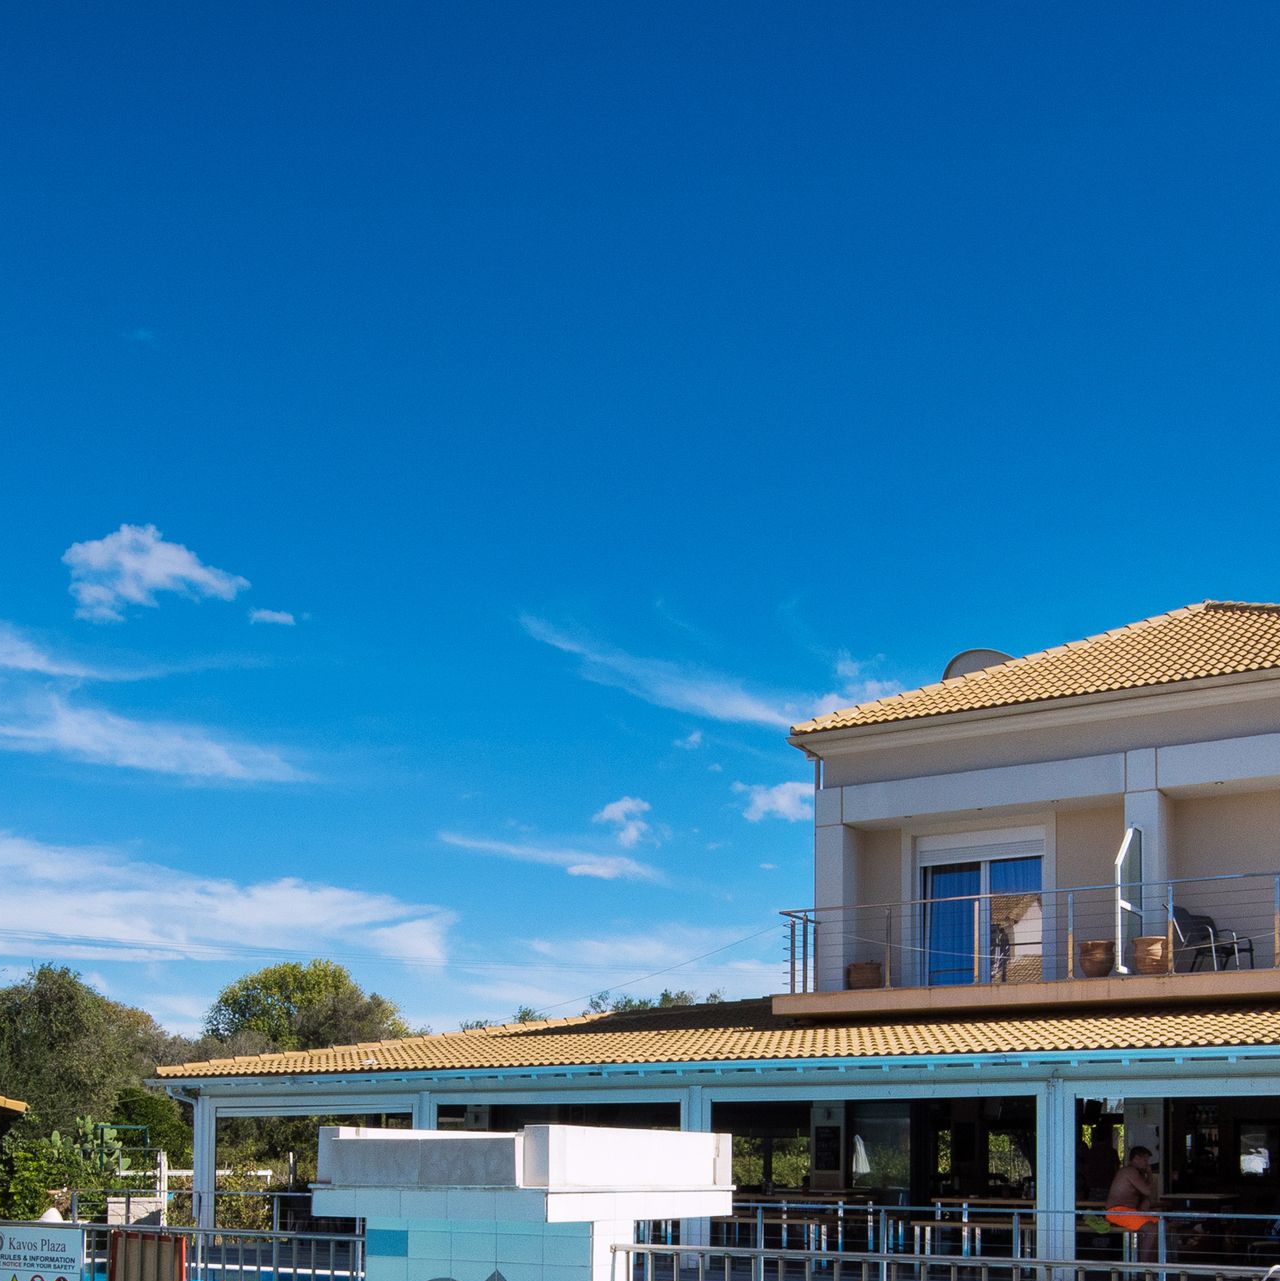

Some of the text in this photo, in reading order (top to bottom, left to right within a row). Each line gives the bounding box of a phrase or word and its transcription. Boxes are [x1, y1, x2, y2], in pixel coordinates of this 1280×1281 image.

[8, 1237, 66, 1252] Kavos Plaza
[0, 1253, 22, 1261] RULES
[22, 1254, 28, 1262] &
[29, 1254, 76, 1264] INFORMATION
[2, 1260, 22, 1268] NOTICE
[53, 1263, 75, 1271] SAFETY
